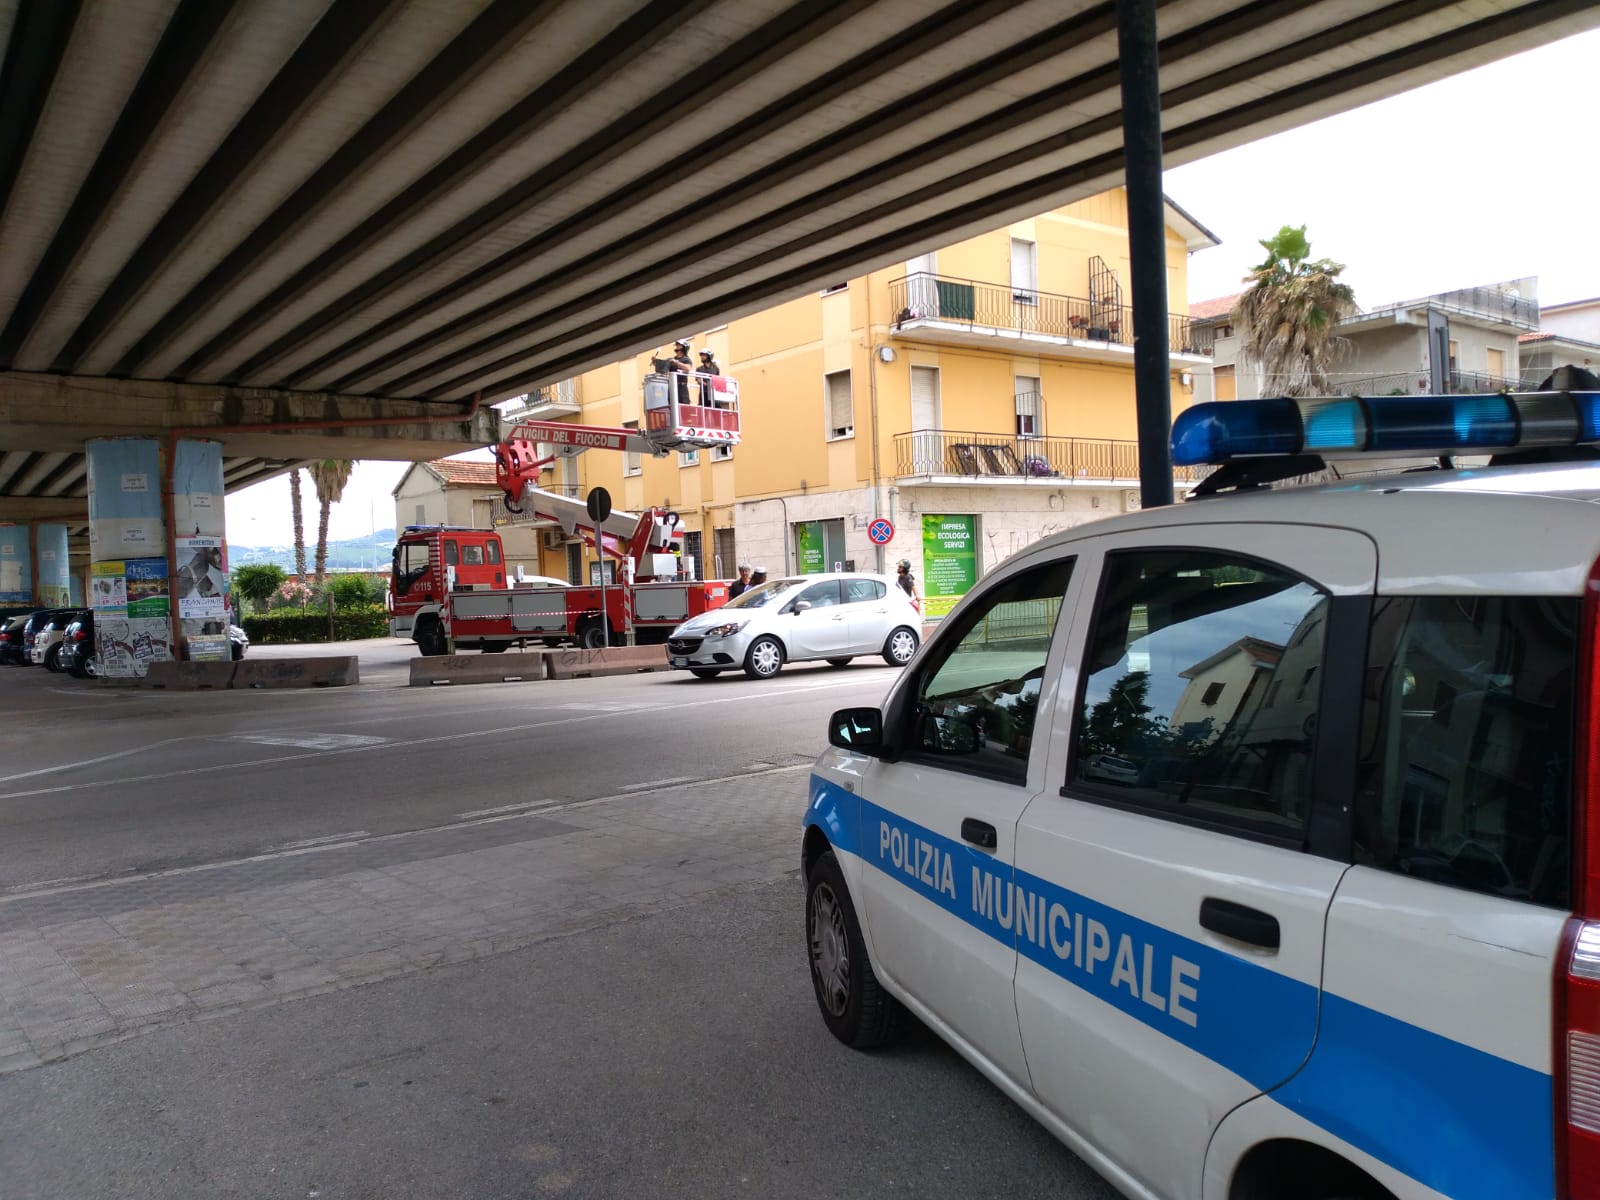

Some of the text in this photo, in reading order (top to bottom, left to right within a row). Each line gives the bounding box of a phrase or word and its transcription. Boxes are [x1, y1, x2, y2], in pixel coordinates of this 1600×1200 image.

[523, 428, 608, 446] VIGILI DEL FUOCO
[879, 820, 1201, 1028] POLIZIA MUNICIPALE
